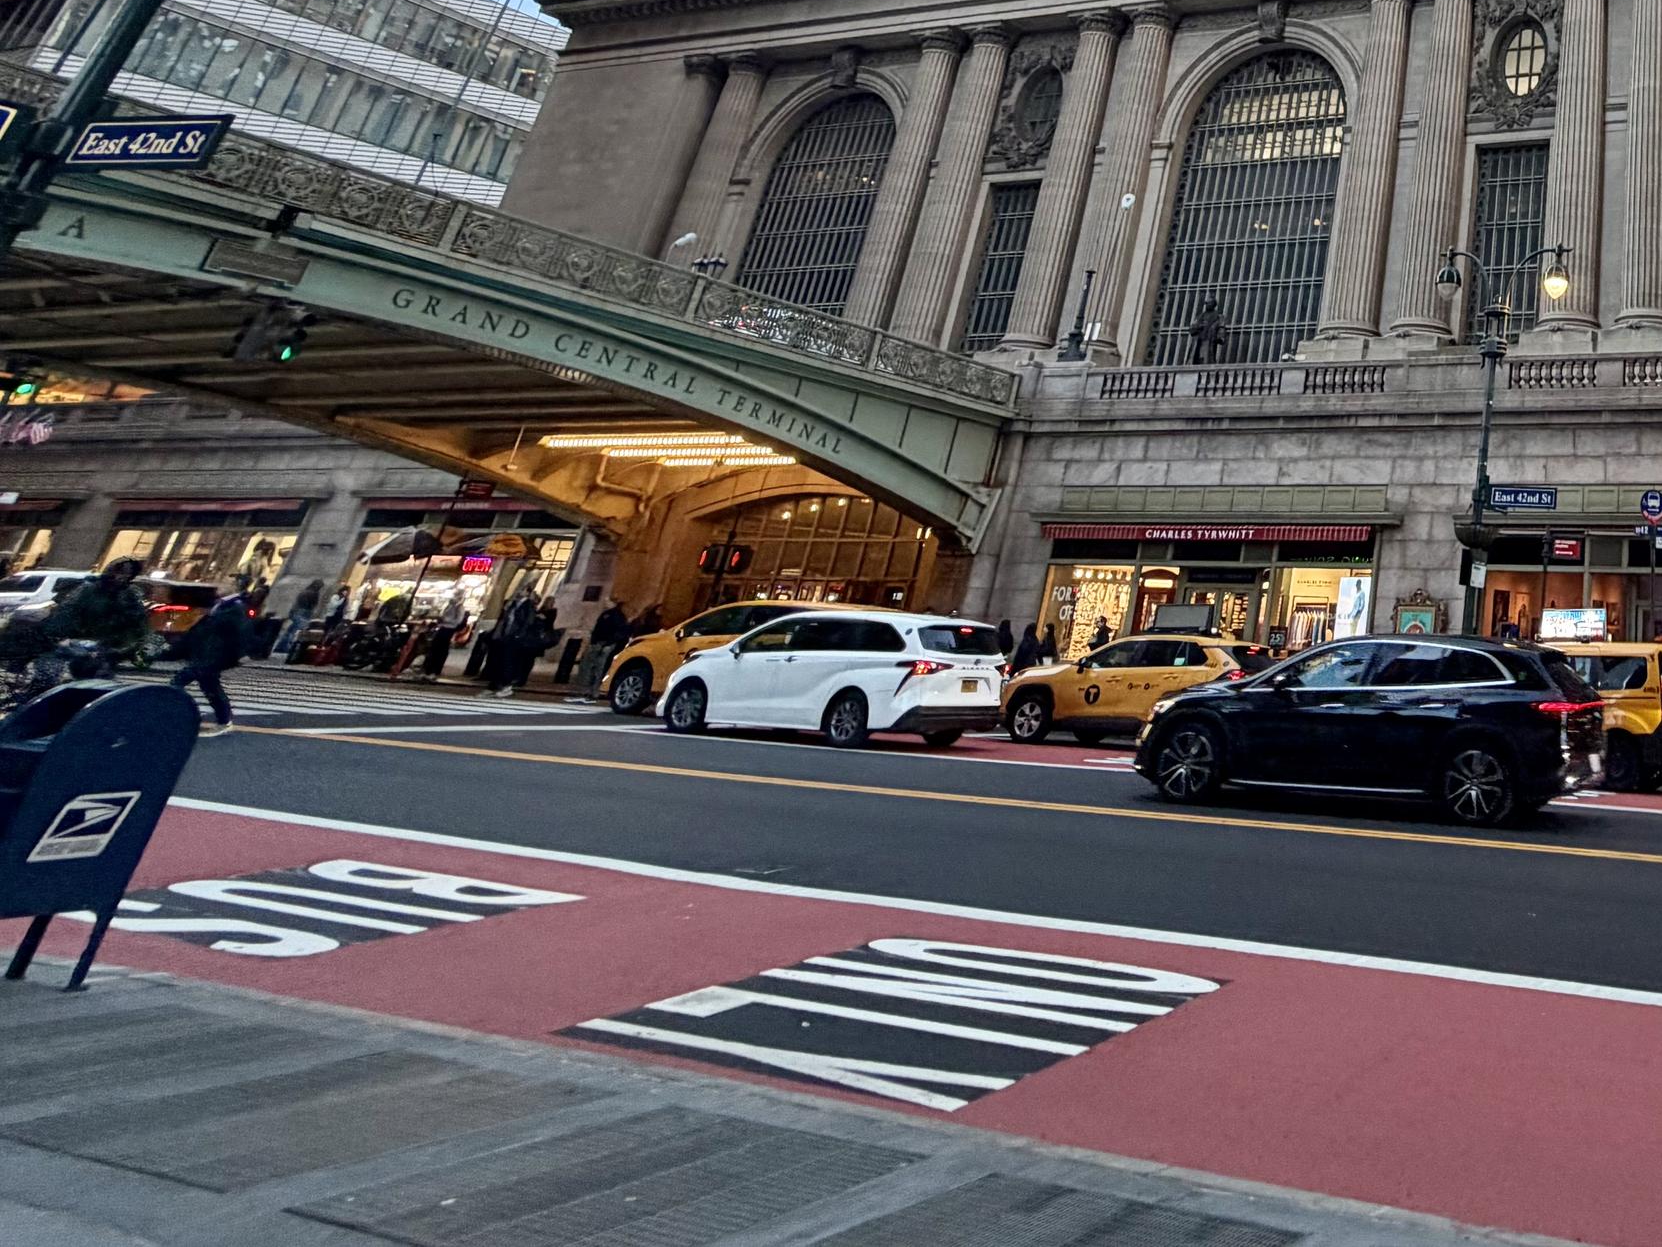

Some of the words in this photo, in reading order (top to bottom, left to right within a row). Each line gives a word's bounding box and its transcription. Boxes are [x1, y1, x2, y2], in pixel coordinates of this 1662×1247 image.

[78, 132, 128, 155] East
[128, 131, 182, 155] 42nd
[178, 130, 207, 154] St
[391, 288, 531, 341] GRAND
[553, 332, 697, 395] CENTRAL
[716, 388, 844, 455] TERMINAL
[1494, 491, 1515, 503] East
[1516, 492, 1539, 504] 42nd
[1541, 493, 1552, 504] St
[1145, 529, 1193, 539] CHARLES
[1197, 529, 1255, 540] TYRWHITT
[462, 559, 491, 572] OPEN
[55, 859, 588, 958] BUS
[575, 938, 1221, 1112] ONLY
